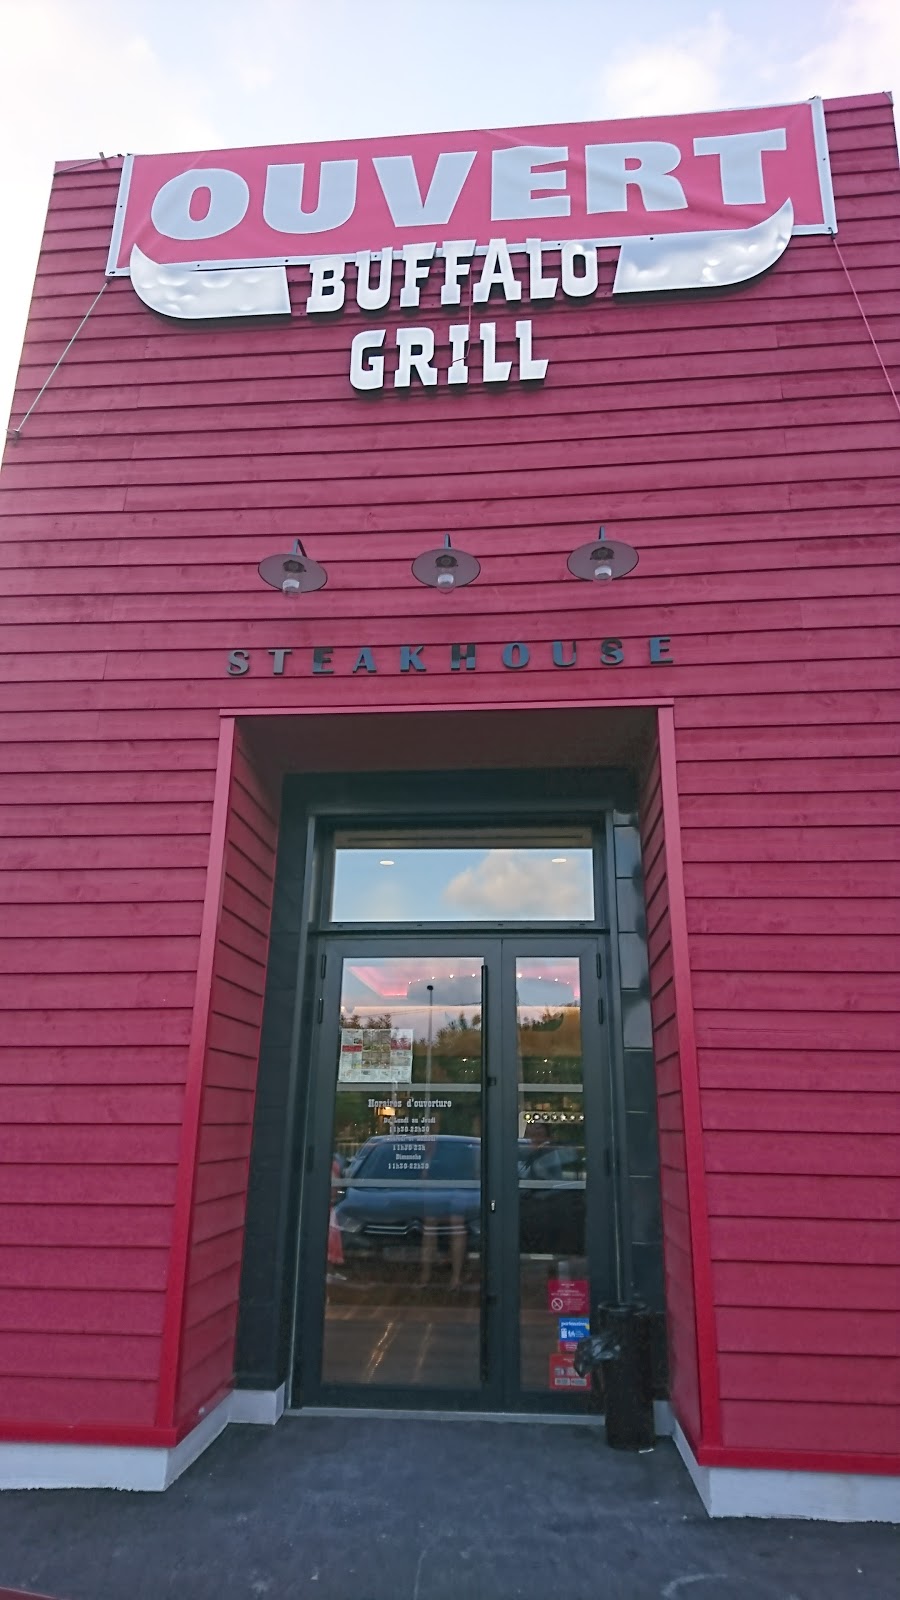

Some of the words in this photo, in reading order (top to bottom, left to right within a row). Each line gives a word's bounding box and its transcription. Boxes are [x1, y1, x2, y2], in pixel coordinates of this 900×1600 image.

[150, 127, 788, 241] OUVERT
[305, 238, 601, 314] BUFFALO
[348, 320, 550, 391] GRILL
[226, 636, 675, 676] STEAKHOUSE
[367, 1098, 403, 1108] Horaires
[406, 1098, 452, 1108] d'ouverture
